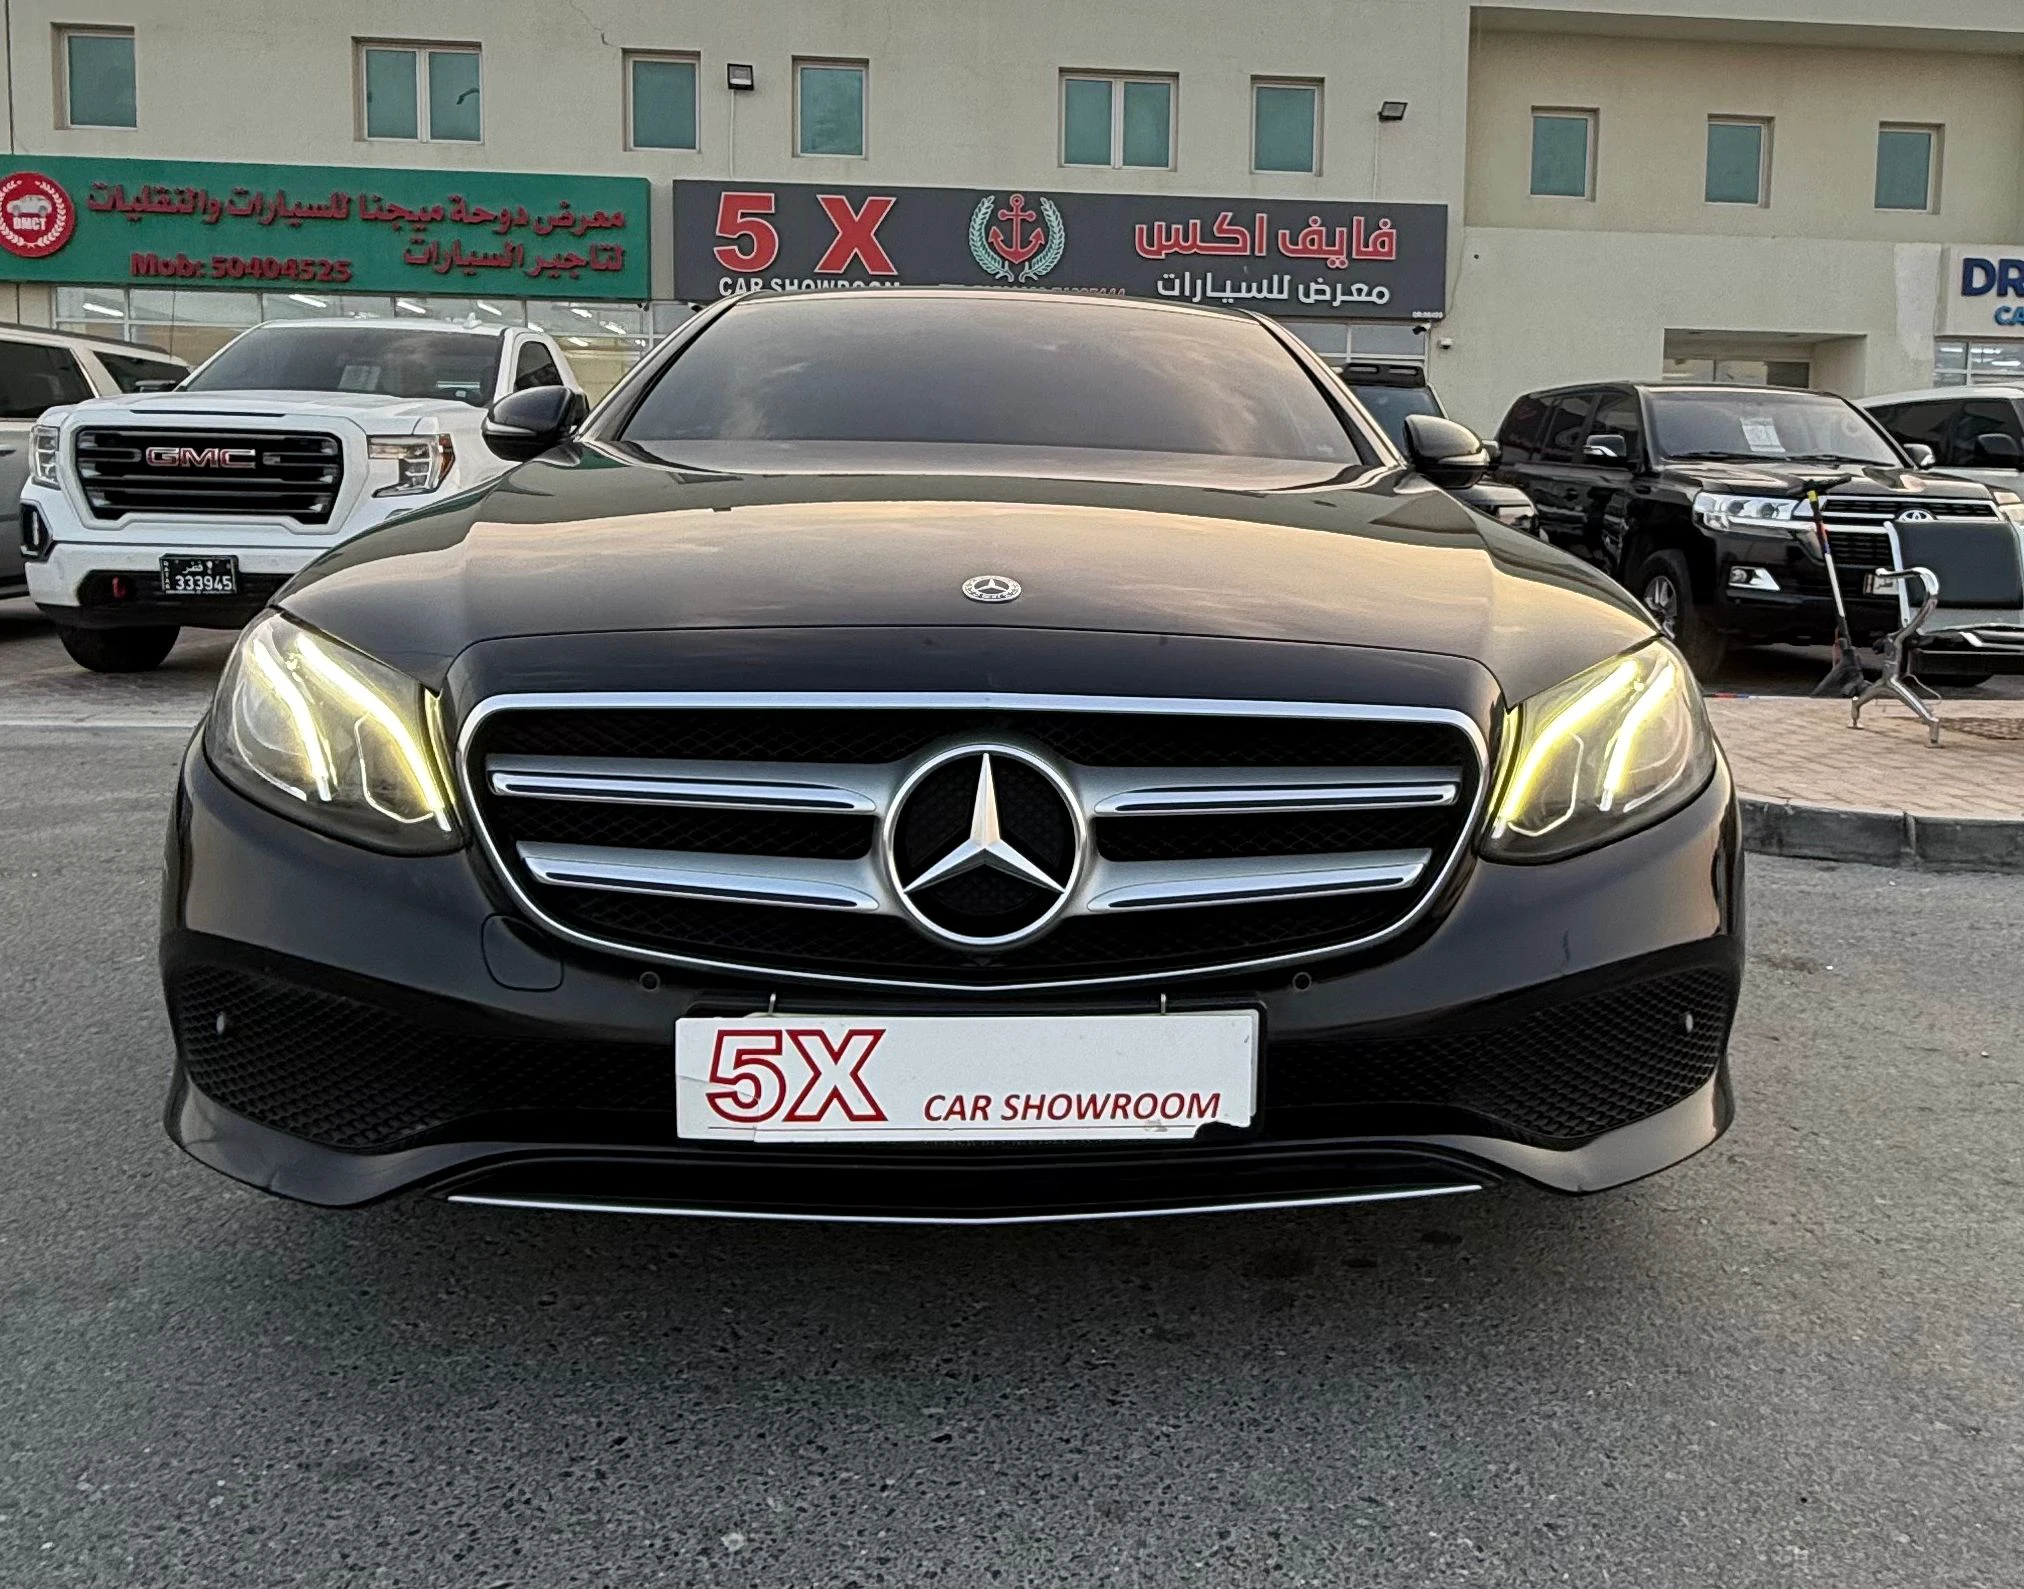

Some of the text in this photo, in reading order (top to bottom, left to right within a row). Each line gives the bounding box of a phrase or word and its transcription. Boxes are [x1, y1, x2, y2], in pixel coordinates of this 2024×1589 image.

[226, 187, 350, 228] للسيارات
[358, 192, 445, 231] ميجنا
[448, 194, 530, 235] دوحة
[532, 200, 625, 236] معرض
[713, 192, 899, 276] 5 X
[1135, 211, 1397, 269] فايف اكس
[131, 252, 352, 283] Mob: 50404525
[403, 236, 626, 278] لتاجير السيارات
[719, 276, 763, 297] CAR
[1156, 271, 1390, 307] معرض للسيارات
[146, 446, 256, 469] GMC
[175, 575, 233, 590] 333945
[705, 1028, 888, 1123] 5X
[923, 1092, 1221, 1122] CAR SHOWROOM
